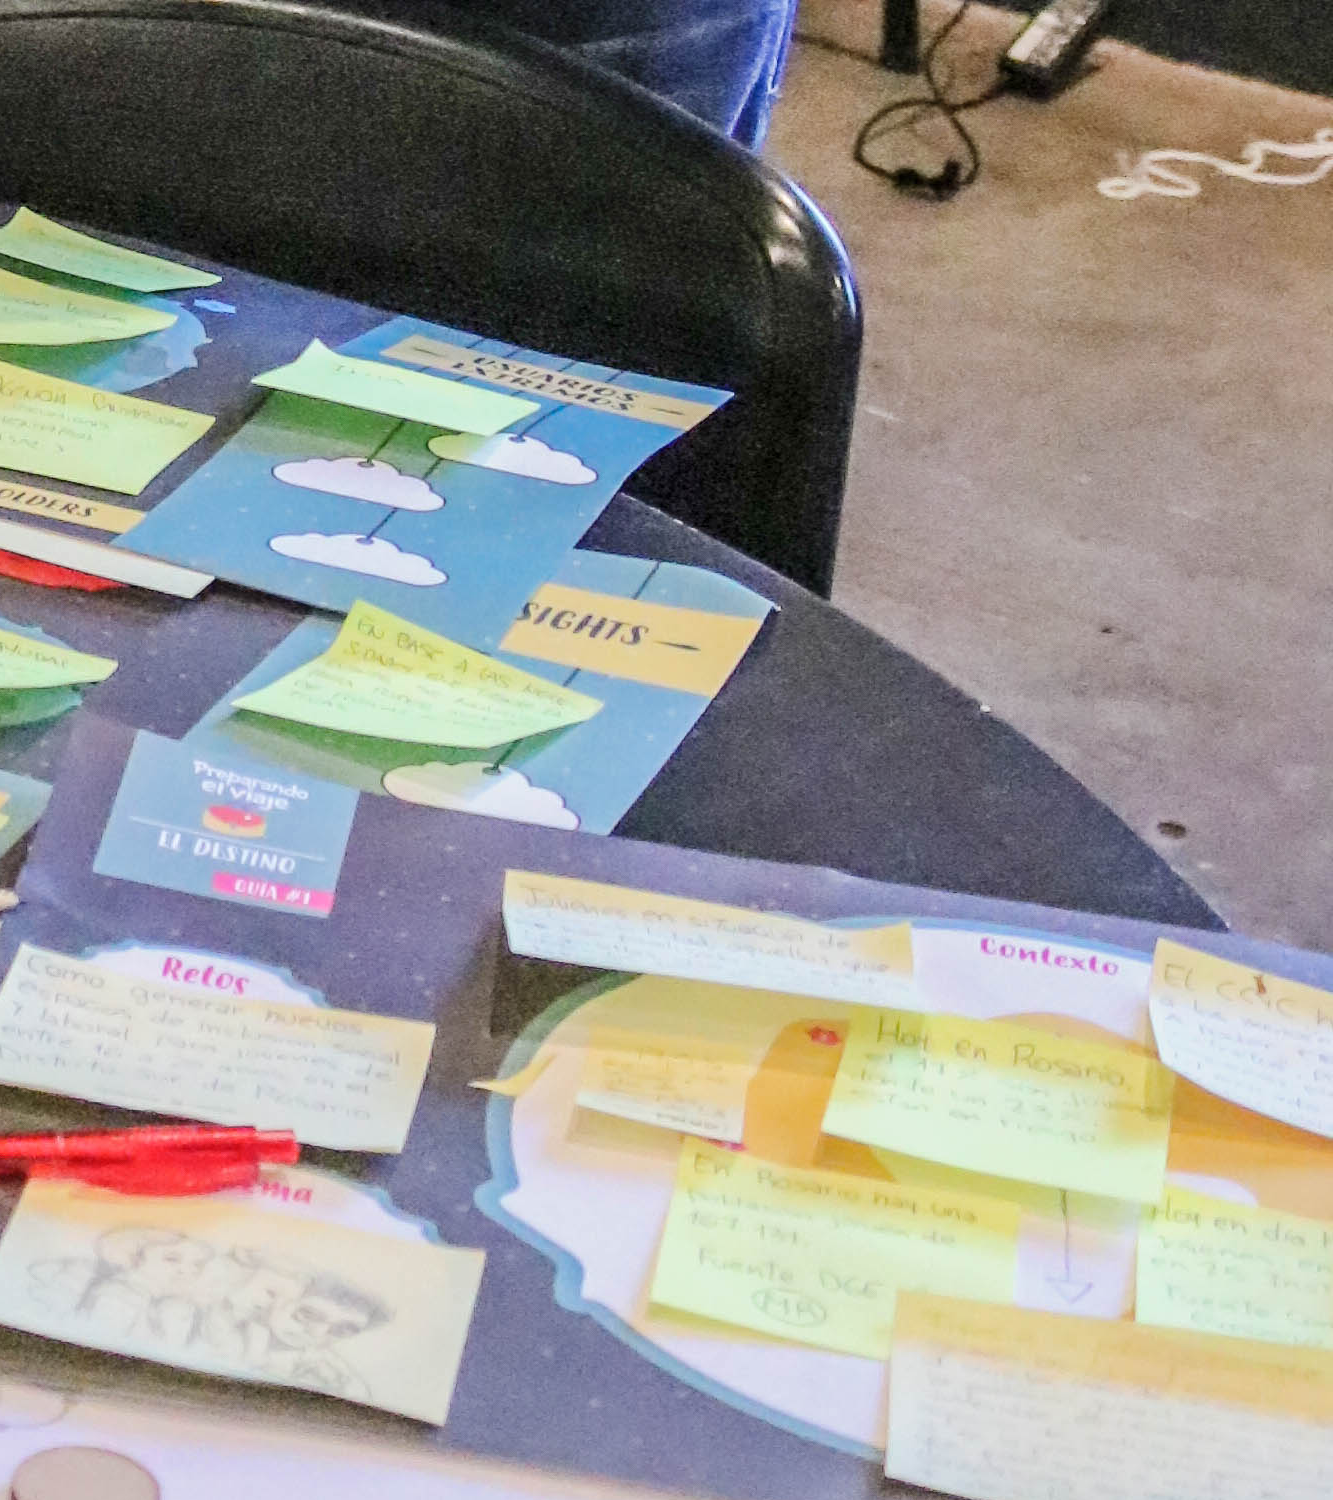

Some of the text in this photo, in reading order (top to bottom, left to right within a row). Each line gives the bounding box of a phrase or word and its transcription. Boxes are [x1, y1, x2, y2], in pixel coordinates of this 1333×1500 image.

[192, 759, 310, 801] Preparando
[201, 778, 290, 813] el viaje
[193, 838, 297, 876] DESTINO
[161, 955, 251, 996] Retos
[981, 936, 1120, 977] Contexto
[956, 1036, 989, 1063] en
